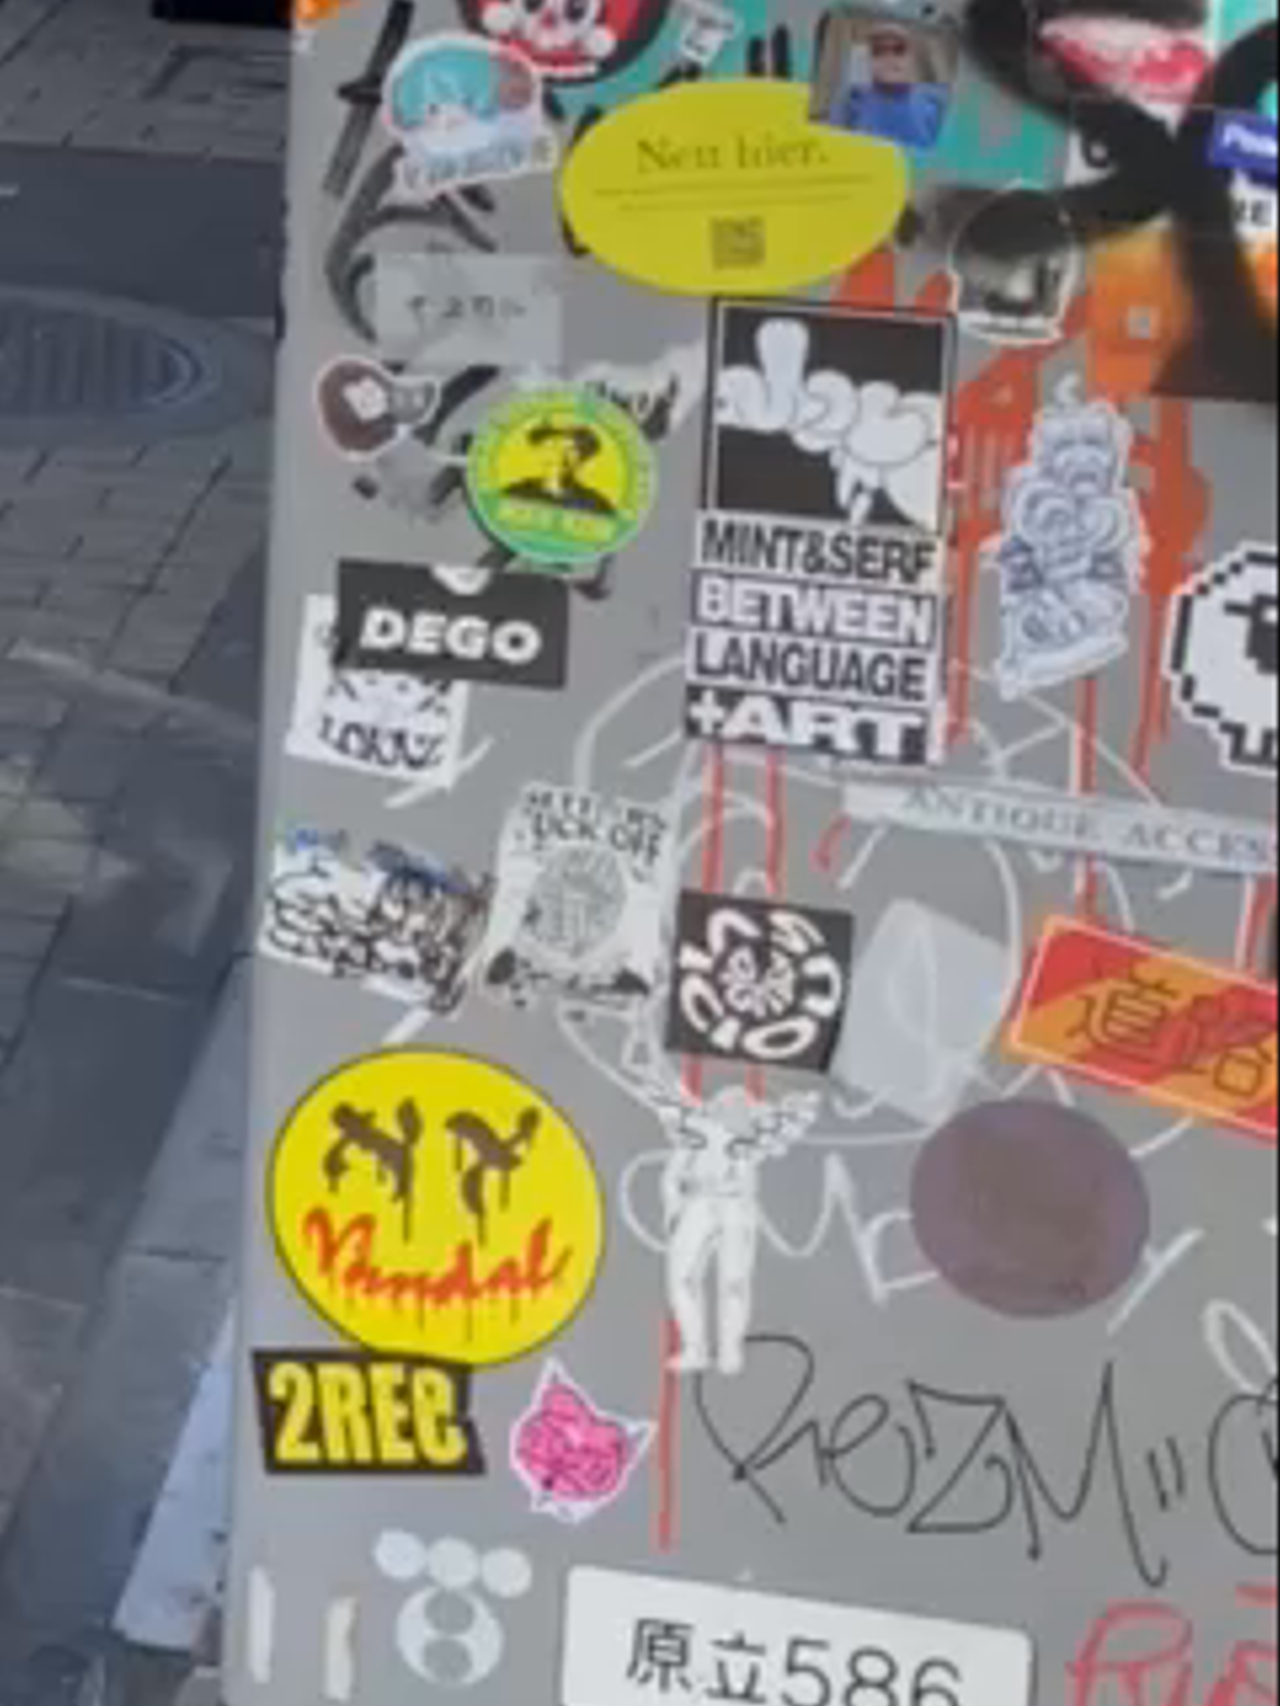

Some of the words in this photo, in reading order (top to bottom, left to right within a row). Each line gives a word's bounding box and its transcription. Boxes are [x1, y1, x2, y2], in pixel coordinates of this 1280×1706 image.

[700, 519, 936, 585] MINT&SERF
[359, 604, 543, 666] DEGO
[696, 576, 932, 643] BETWEEN
[693, 632, 927, 701] LANGUAGE
[898, 782, 1088, 839] ANTIQUE
